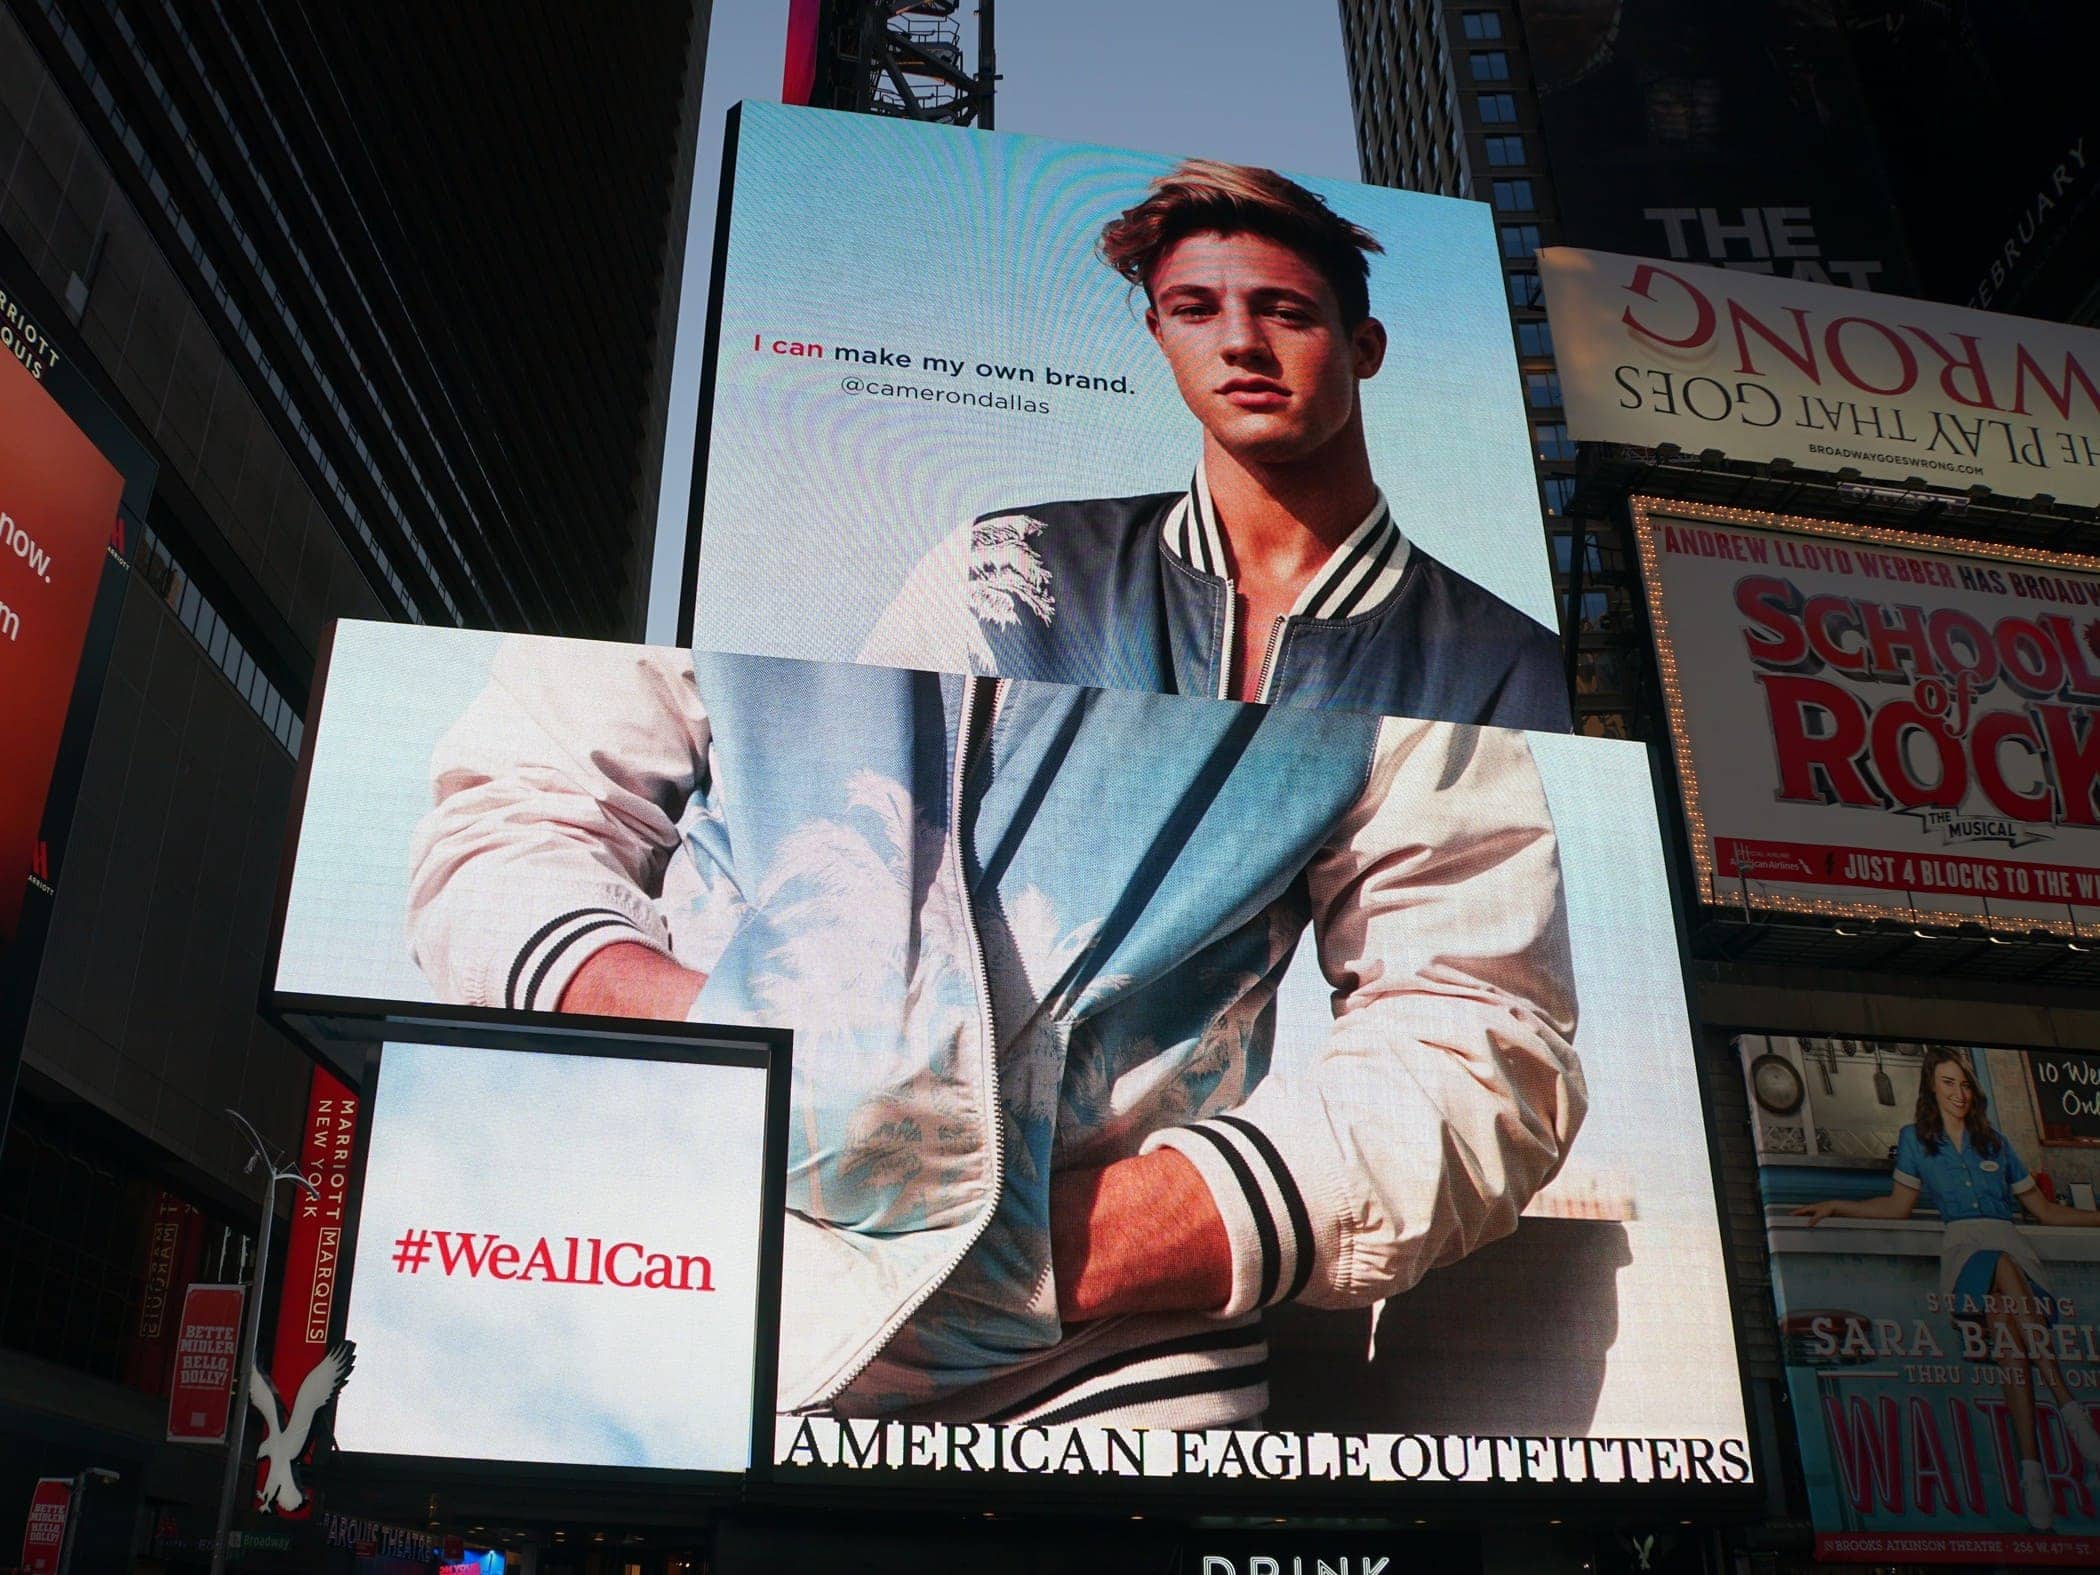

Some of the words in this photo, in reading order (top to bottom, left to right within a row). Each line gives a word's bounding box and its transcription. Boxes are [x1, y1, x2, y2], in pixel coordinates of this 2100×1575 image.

[1643, 207, 1823, 258] THE
[0, 326, 42, 380] QUIS
[754, 334, 761, 351] I
[772, 339, 824, 358] can
[835, 345, 911, 368] make
[923, 355, 964, 378] my
[976, 363, 1034, 382] own
[1046, 367, 1135, 394] brand.
[1621, 264, 2100, 421] WRONG
[841, 376, 1050, 415] @camerondallas
[1615, 366, 1781, 427] GOES
[1796, 396, 1916, 441] THAT
[1809, 444, 1983, 475] BROADWAYGOESWRONG.COM
[1925, 411, 2050, 468] PLAY
[1774, 541, 1853, 574] LLOYD
[1856, 552, 1957, 589] WEBBER
[1957, 565, 2007, 595] HAS
[1733, 574, 2100, 703] SCHOOL
[1914, 668, 1978, 738] of
[1753, 671, 2100, 829] ROCK
[1929, 813, 1951, 824] THE
[1950, 822, 2016, 837] MUSICAL
[1844, 854, 1895, 883] JUST
[1903, 859, 1915, 885] 4
[1920, 860, 2000, 891] BLOCKS
[2003, 867, 2029, 893] TO
[2032, 870, 2072, 898] THE
[2038, 1062, 2059, 1082] 10
[2061, 1060, 2100, 1085] We
[313, 1100, 333, 1149] NEW
[325, 1100, 356, 1220] MARRIOTT
[302, 1158, 325, 1218] YORK
[309, 1231, 336, 1340] MARQUIS
[392, 1229, 715, 1291] #WeAllCan
[1928, 1293, 2076, 1318] STARRING
[180, 1339, 234, 1355] MIDLER
[186, 1325, 234, 1340] BETTE
[1809, 1317, 1945, 1358] SARA
[1904, 1365, 1962, 1385] THRU
[1971, 1366, 2026, 1386] JUNE
[2032, 1367, 2058, 1388] 11
[786, 1415, 1150, 1477] AMERICAN
[1172, 1429, 1370, 1480] EAGLE
[1391, 1434, 1751, 1485] OUTFITTERS
[1822, 1396, 2100, 1519] WAITR
[243, 1535, 290, 1550] Broadway
[1834, 1540, 1883, 1554] BROOKS
[1886, 1540, 1946, 1554] ATKINSON
[1950, 1541, 2003, 1554] THEATRE
